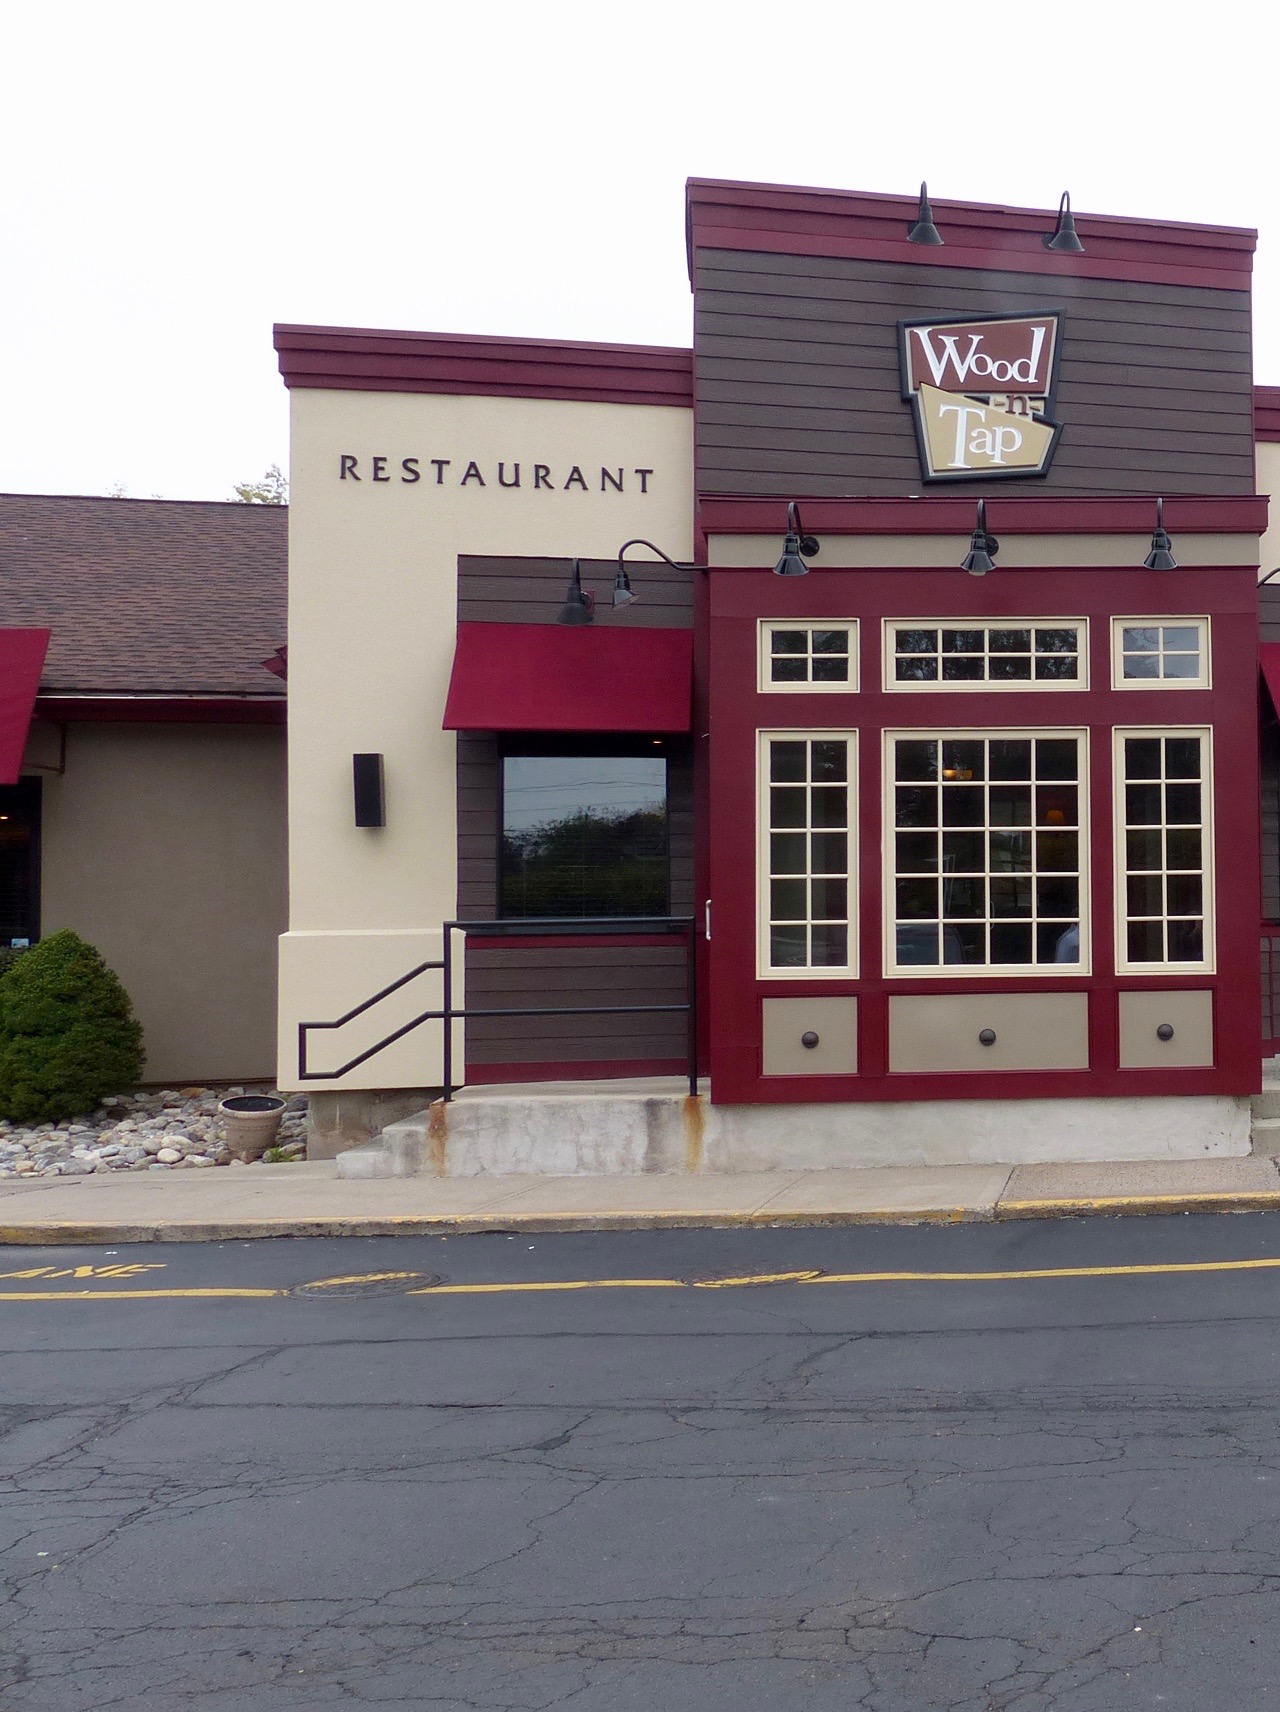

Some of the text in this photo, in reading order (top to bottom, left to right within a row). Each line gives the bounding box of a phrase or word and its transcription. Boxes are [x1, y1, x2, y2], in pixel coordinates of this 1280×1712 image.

[913, 326, 1046, 387] Wood
[938, 403, 1023, 469] Tap
[339, 454, 654, 493] RESTAURANT
